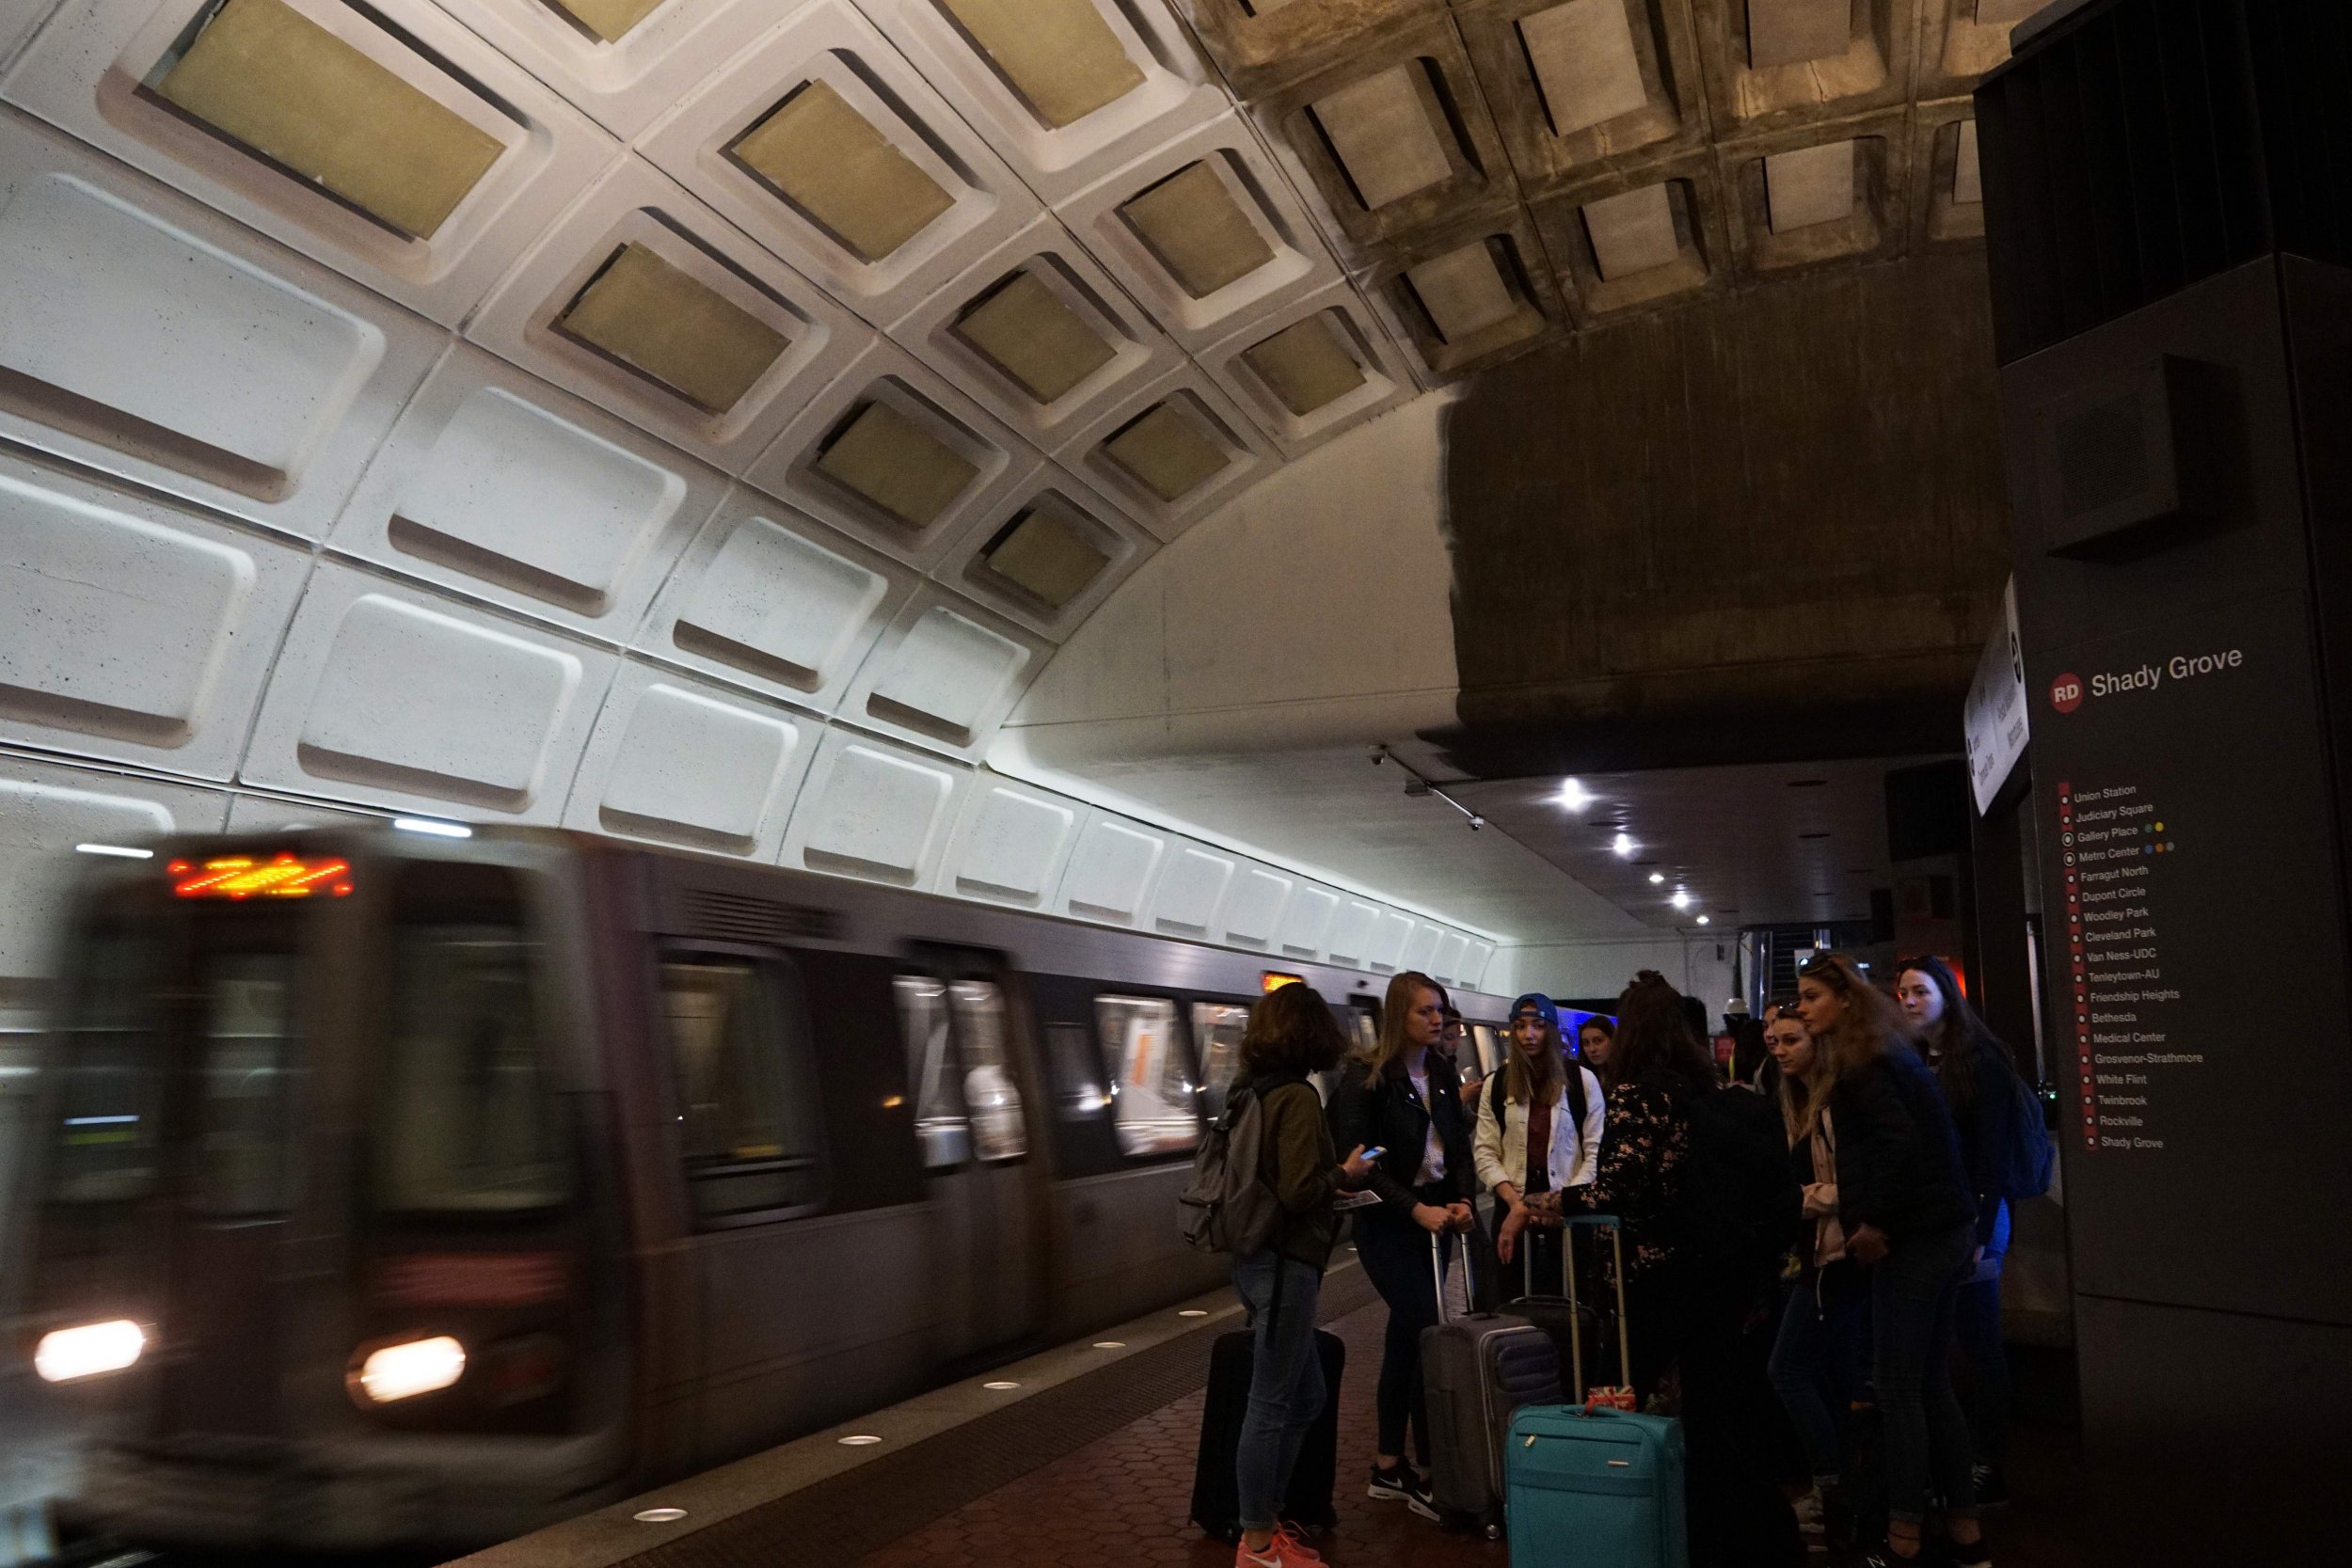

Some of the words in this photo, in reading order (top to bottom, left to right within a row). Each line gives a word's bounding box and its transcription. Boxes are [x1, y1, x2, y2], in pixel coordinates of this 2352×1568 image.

[2053, 683, 2080, 704] RD
[2091, 663, 2162, 697] Shady
[2169, 649, 2243, 680] Grove
[2074, 791, 2102, 803] Union
[2102, 785, 2137, 799] Station
[2074, 809, 2118, 824] Judiciary
[2118, 803, 2154, 817] Square
[2076, 831, 2110, 843] Gallery
[2110, 826, 2139, 838] Place
[2078, 851, 2106, 863] Metro
[2106, 847, 2140, 859] Center
[2080, 869, 2121, 882] Farragut
[2121, 864, 2150, 878] North
[2082, 890, 2118, 903] Dupont
[2117, 886, 2147, 899] Circle
[2083, 911, 2125, 923] Woodley
[2125, 907, 2150, 918] Park
[2084, 930, 2132, 942] Cleveland
[2133, 927, 2157, 939] Park
[2086, 952, 2106, 962] Van
[2106, 947, 2157, 961] Ness-UDC
[2088, 968, 2161, 984] Tenleytown-AU
[2090, 990, 2140, 1004] Friendship
[2140, 989, 2181, 1003] Heights
[2090, 1011, 2137, 1023] Bethesda
[2092, 1032, 2131, 1044] Medical
[2132, 1031, 2167, 1043] Center
[2094, 1052, 2204, 1065] Grosvenor-Strathmore
[2095, 1073, 2124, 1085] White
[2124, 1073, 2148, 1085] Flint
[2097, 1094, 2148, 1106] Twinbrook
[2099, 1115, 2144, 1127] Rockville
[2101, 1135, 2132, 1150] Shady
[2133, 1136, 2165, 1149] Grove
